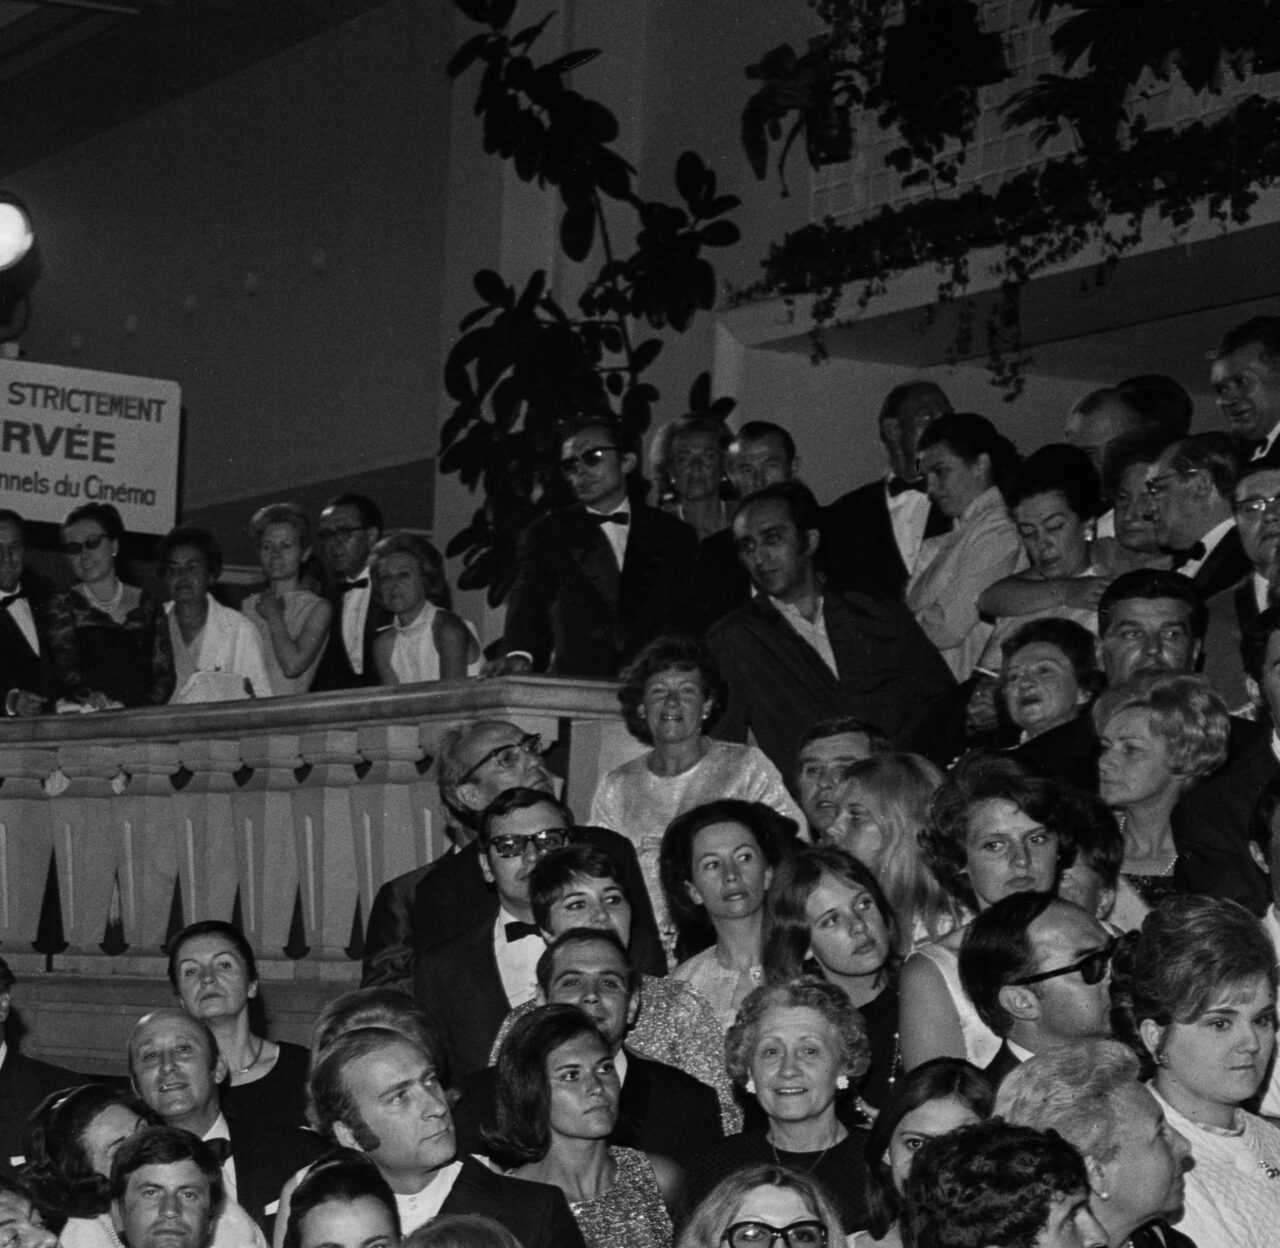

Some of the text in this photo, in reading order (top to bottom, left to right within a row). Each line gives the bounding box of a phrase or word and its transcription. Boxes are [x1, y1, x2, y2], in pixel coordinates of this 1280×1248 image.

[8, 381, 167, 423] STRICTEMENT
[54, 477, 80, 498] du
[84, 474, 157, 506] Cinéma
